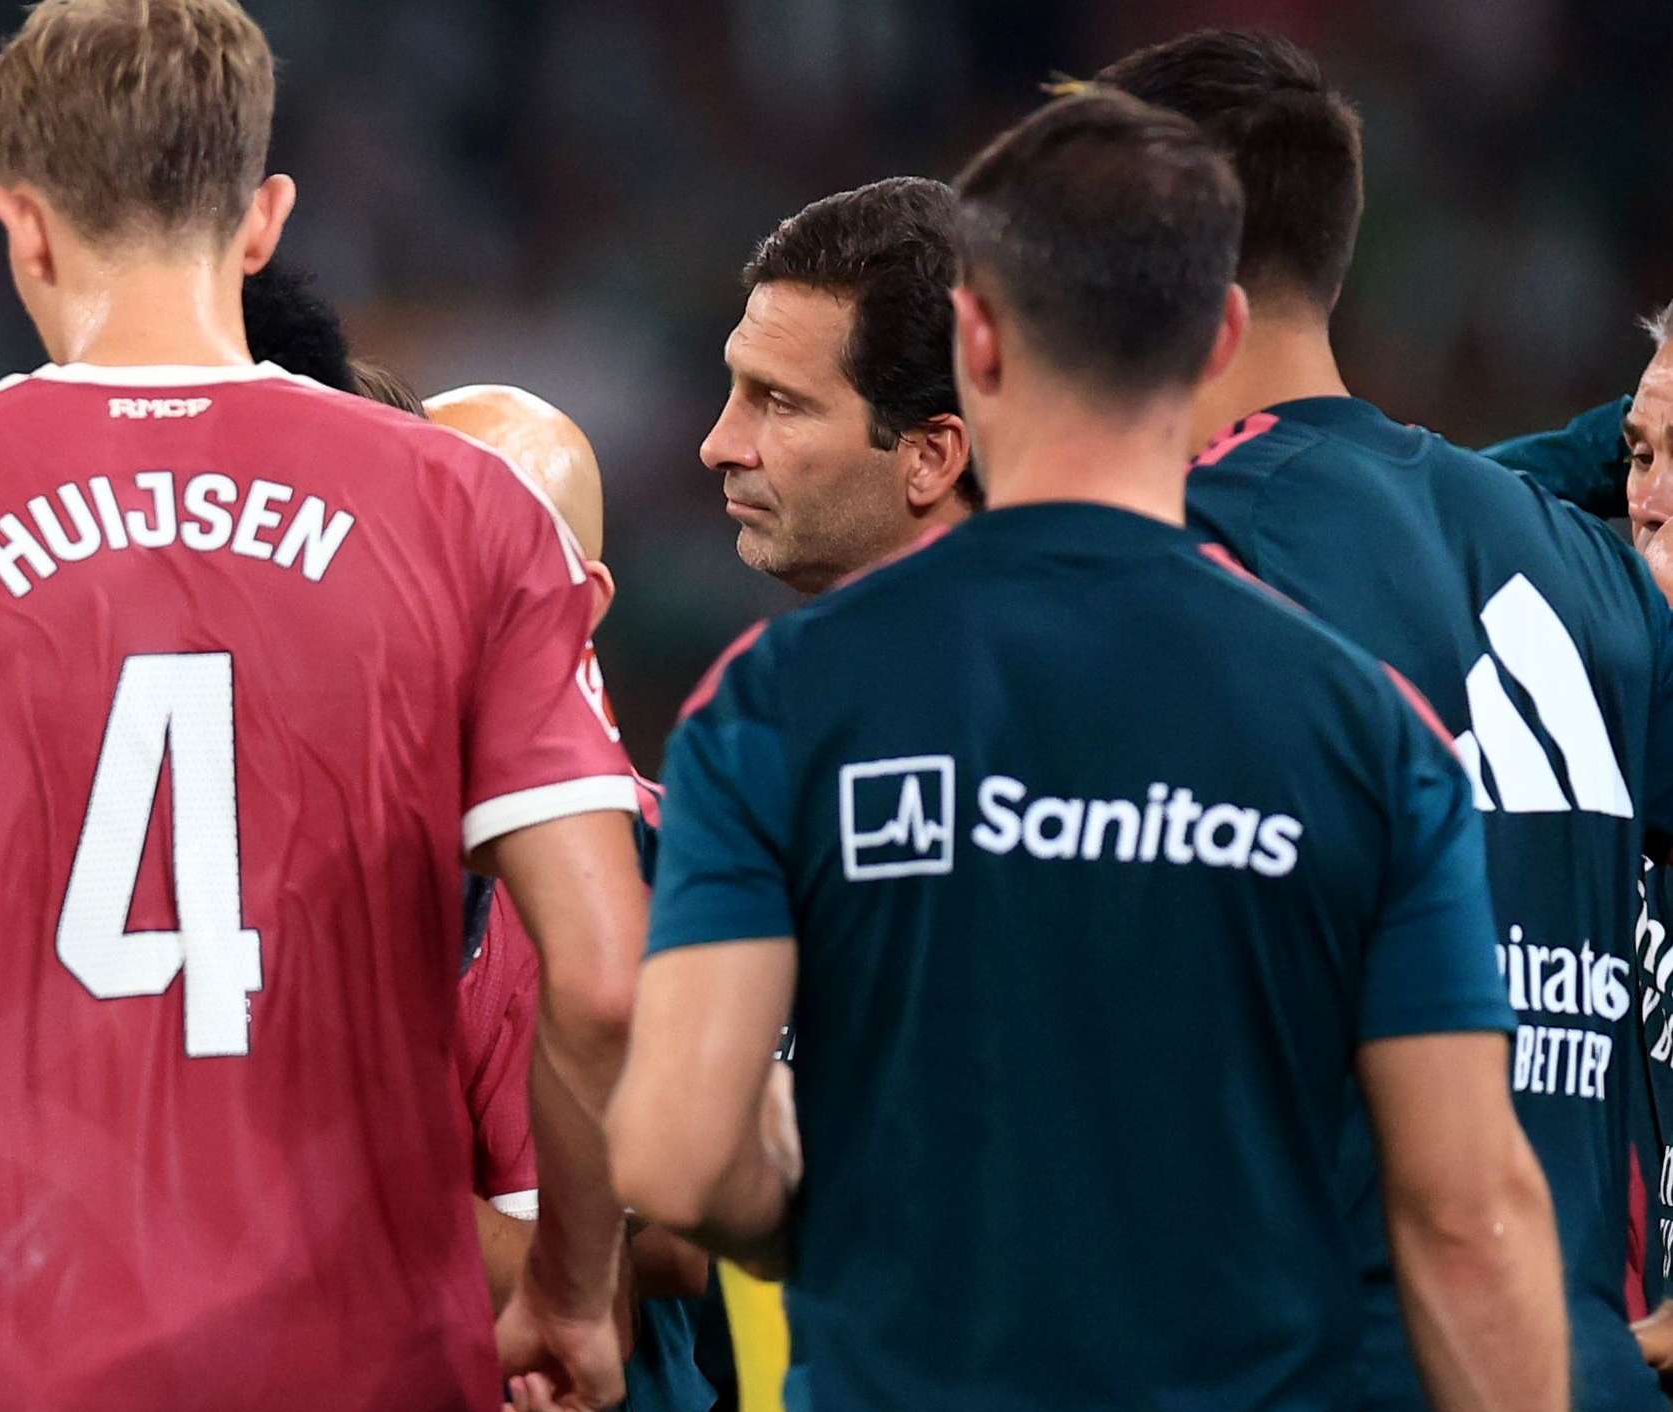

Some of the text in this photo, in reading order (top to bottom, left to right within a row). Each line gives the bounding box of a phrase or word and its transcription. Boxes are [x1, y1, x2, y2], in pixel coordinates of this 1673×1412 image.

[55, 652, 264, 1058] 4
[971, 774, 1304, 878] Sanitas
[1513, 1024, 1613, 1102] BETTER
